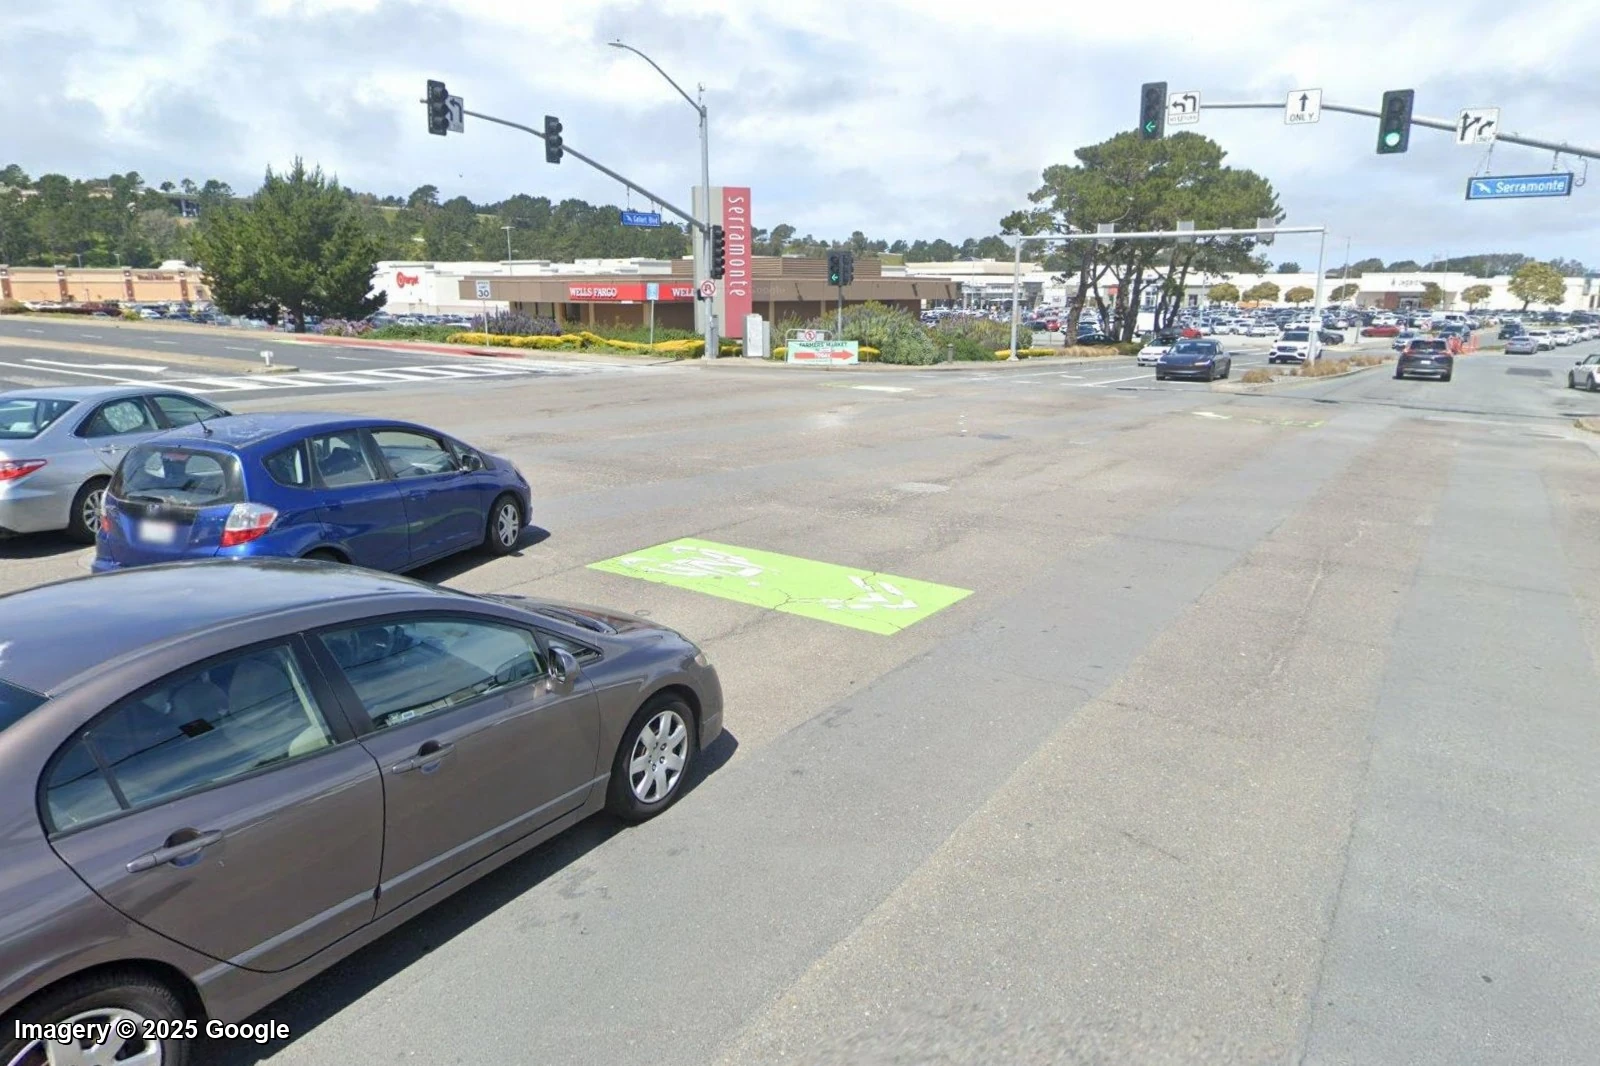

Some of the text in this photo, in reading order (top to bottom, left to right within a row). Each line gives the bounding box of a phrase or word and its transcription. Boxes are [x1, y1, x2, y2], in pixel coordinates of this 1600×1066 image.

[1290, 112, 1315, 121] ONLY
[1495, 180, 1565, 193] Serramonte
[478, 289, 489, 297] 30
[569, 287, 617, 297] WELLS FARGO
